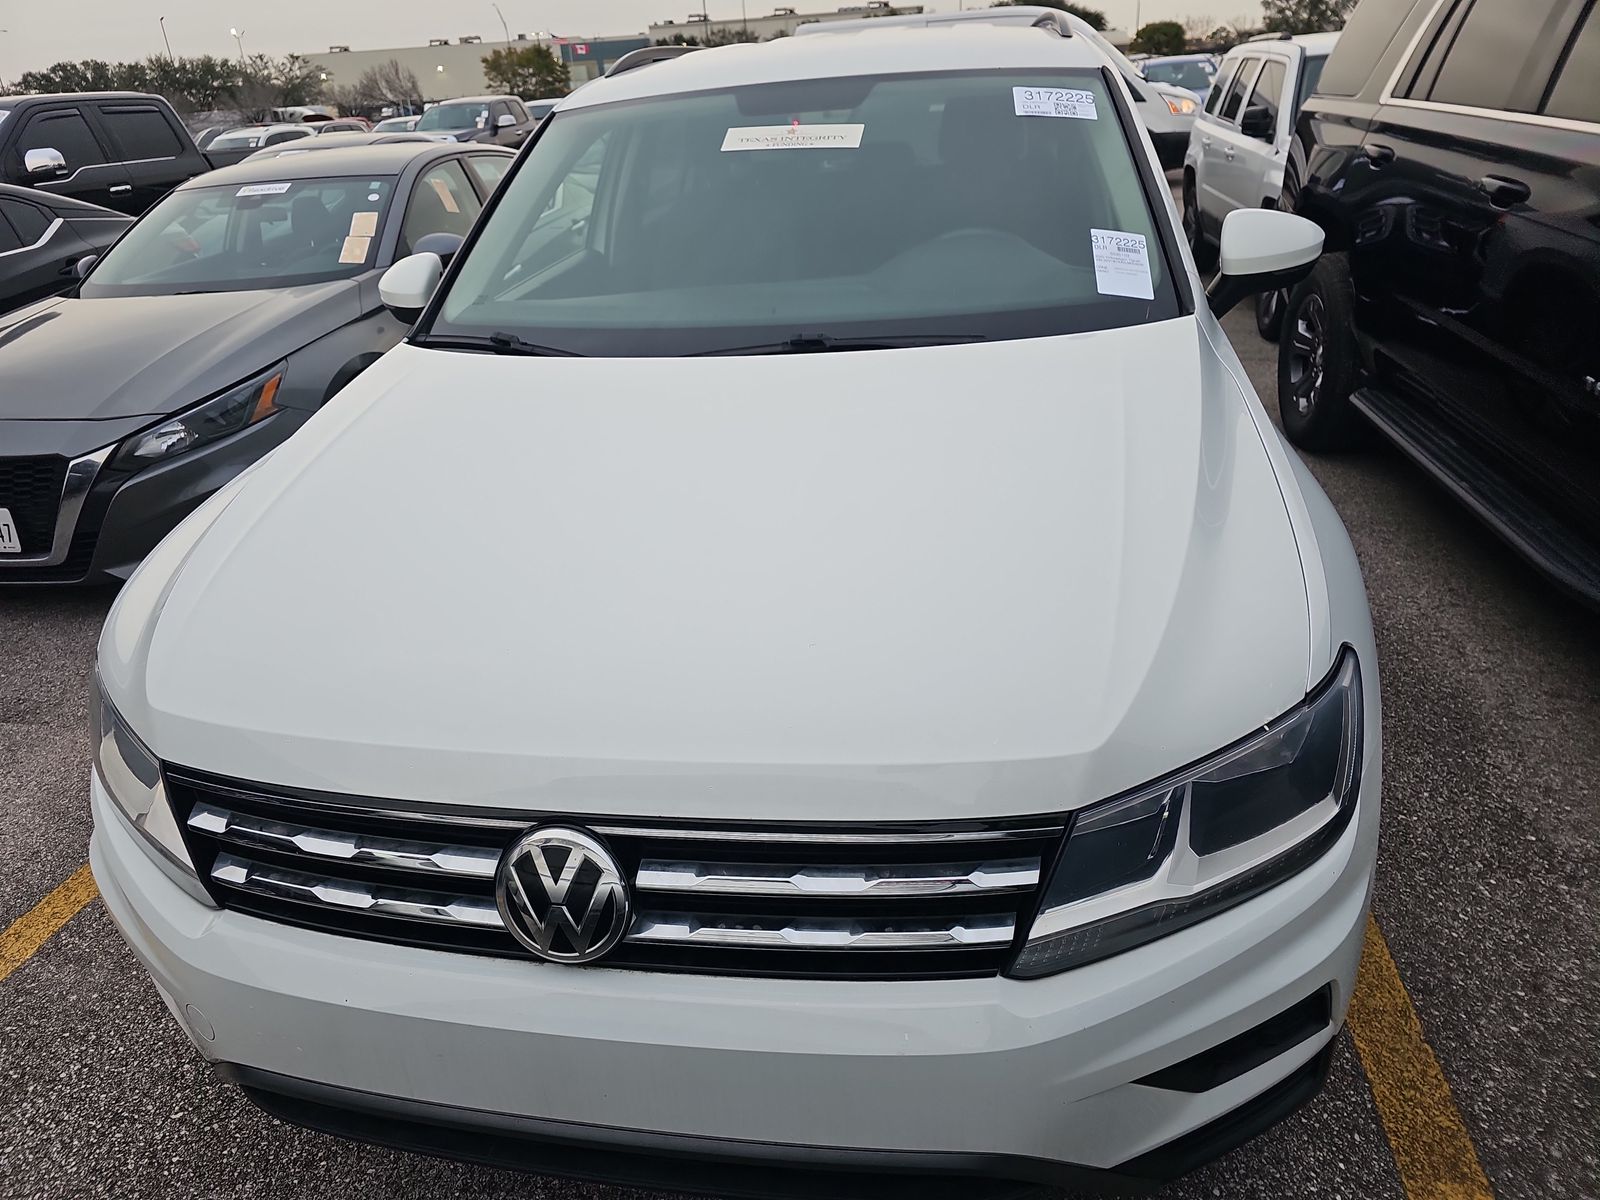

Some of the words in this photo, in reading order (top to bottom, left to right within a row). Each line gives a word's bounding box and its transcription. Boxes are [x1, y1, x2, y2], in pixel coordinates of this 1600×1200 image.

[1024, 90, 1095, 104] 3172225
[780, 134, 847, 142] INTEGRITY
[1091, 234, 1146, 250] 3172225
